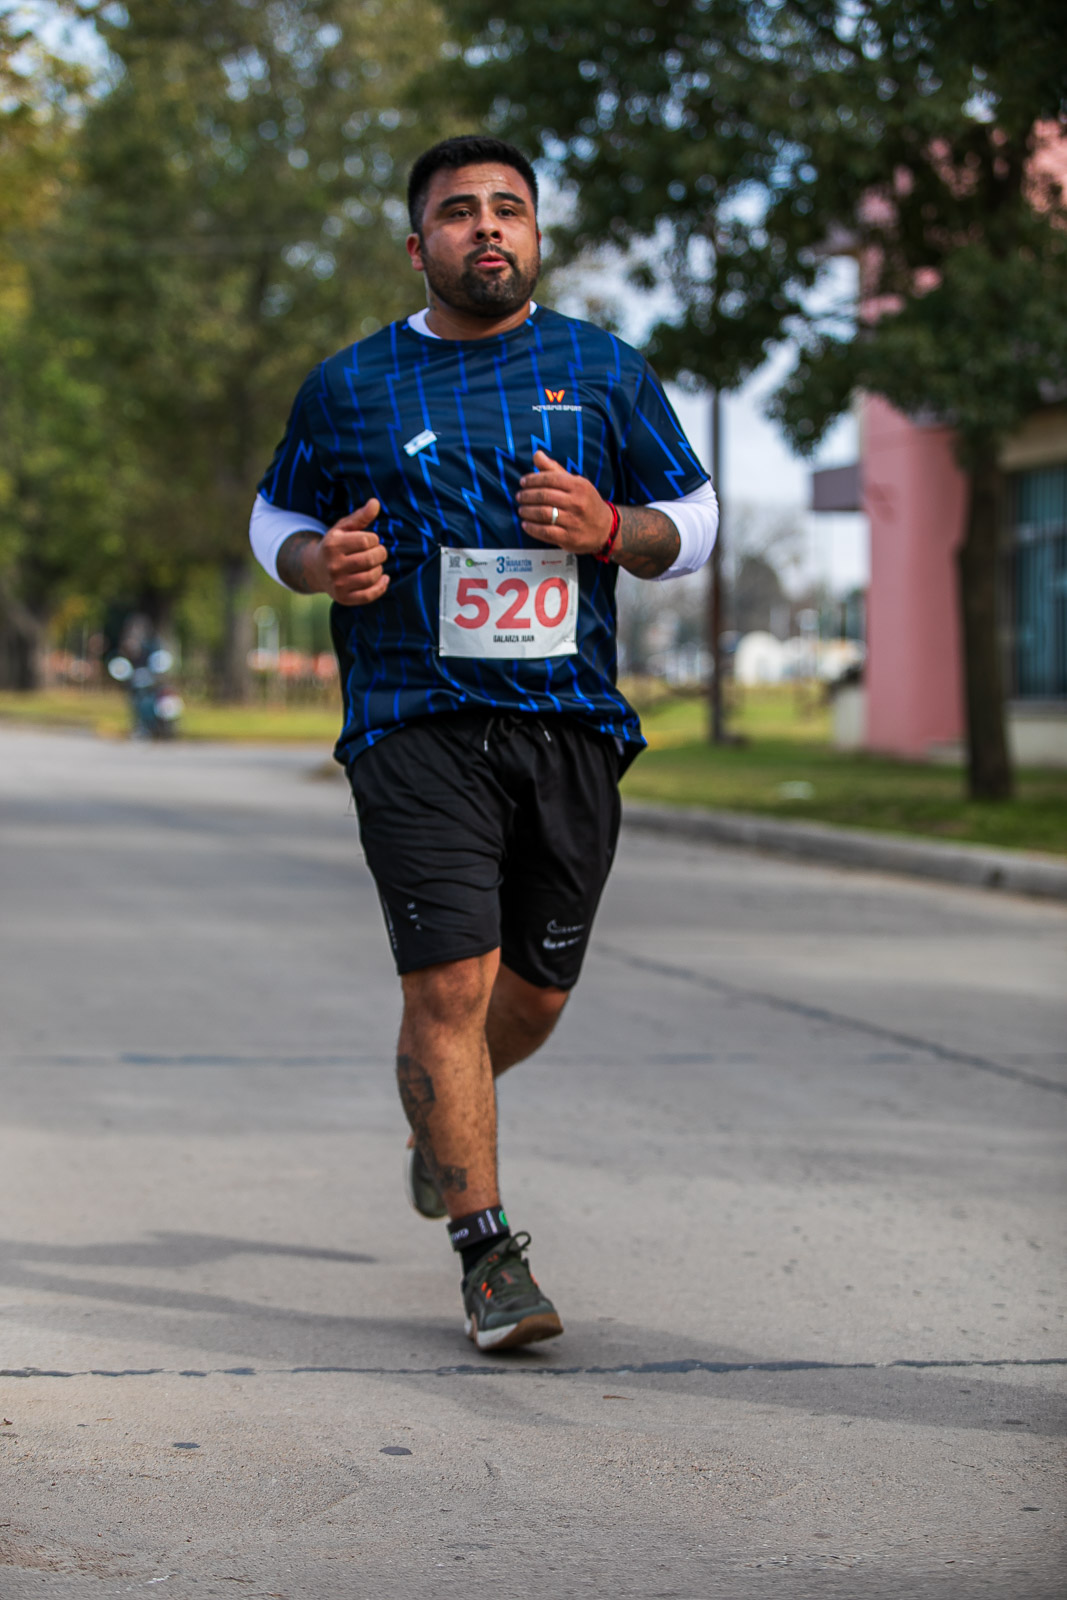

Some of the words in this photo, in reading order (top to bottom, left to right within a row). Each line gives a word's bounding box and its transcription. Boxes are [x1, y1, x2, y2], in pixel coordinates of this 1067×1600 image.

[453, 577, 569, 629] 520
[493, 634, 519, 643] GALARZA
[521, 634, 535, 642] JUAN
